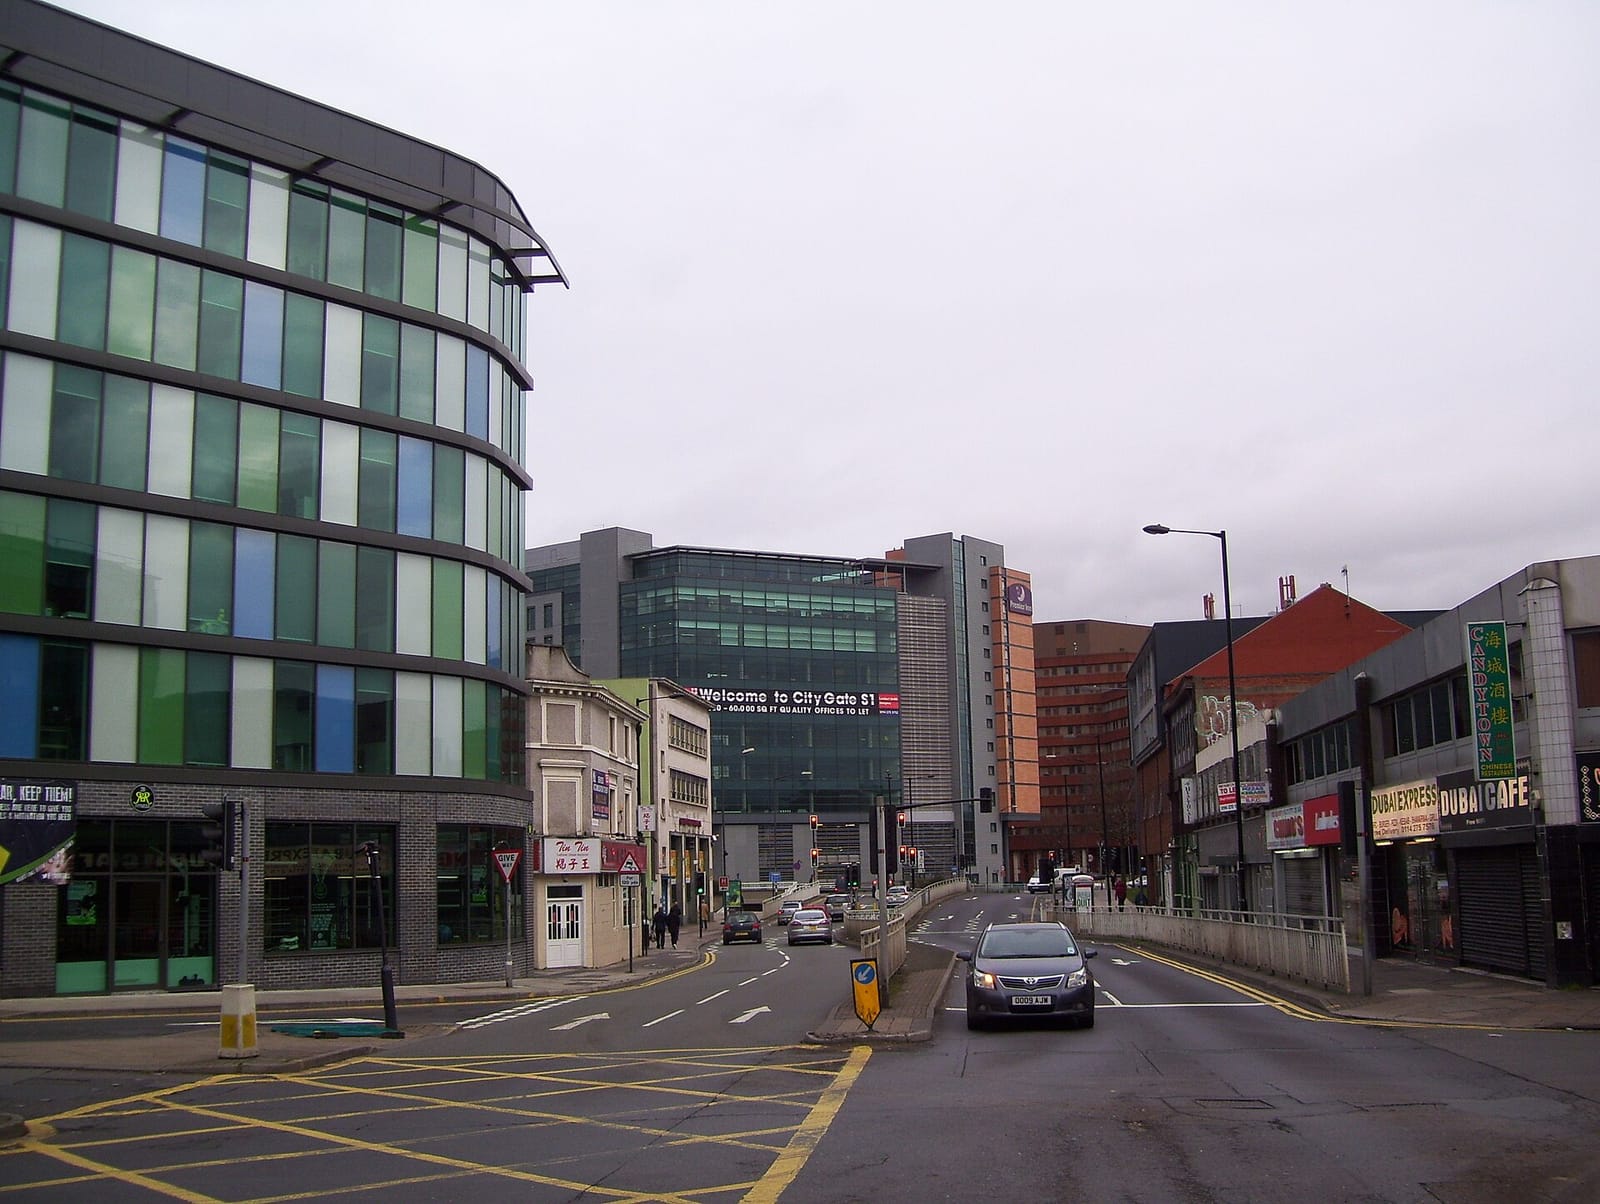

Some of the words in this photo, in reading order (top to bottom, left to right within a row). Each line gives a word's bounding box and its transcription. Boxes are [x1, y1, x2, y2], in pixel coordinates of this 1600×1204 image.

[699, 688, 767, 703] Welcome
[774, 691, 788, 703] to
[861, 694, 875, 706] S1
[1470, 627, 1493, 762] CANDYTOWN
[780, 706, 811, 714] QUALITY
[815, 707, 844, 715] OFFICES
[20, 786, 41, 801] KEEP
[45, 787, 73, 802] THEM!
[1372, 792, 1396, 815] DUBAI
[1397, 783, 1437, 811] EXPRESS
[1440, 784, 1484, 817] DUBAI
[1485, 775, 1529, 811] CAFE
[556, 841, 571, 852] Tin
[575, 841, 589, 852] Tin
[498, 854, 515, 862] GIVE
